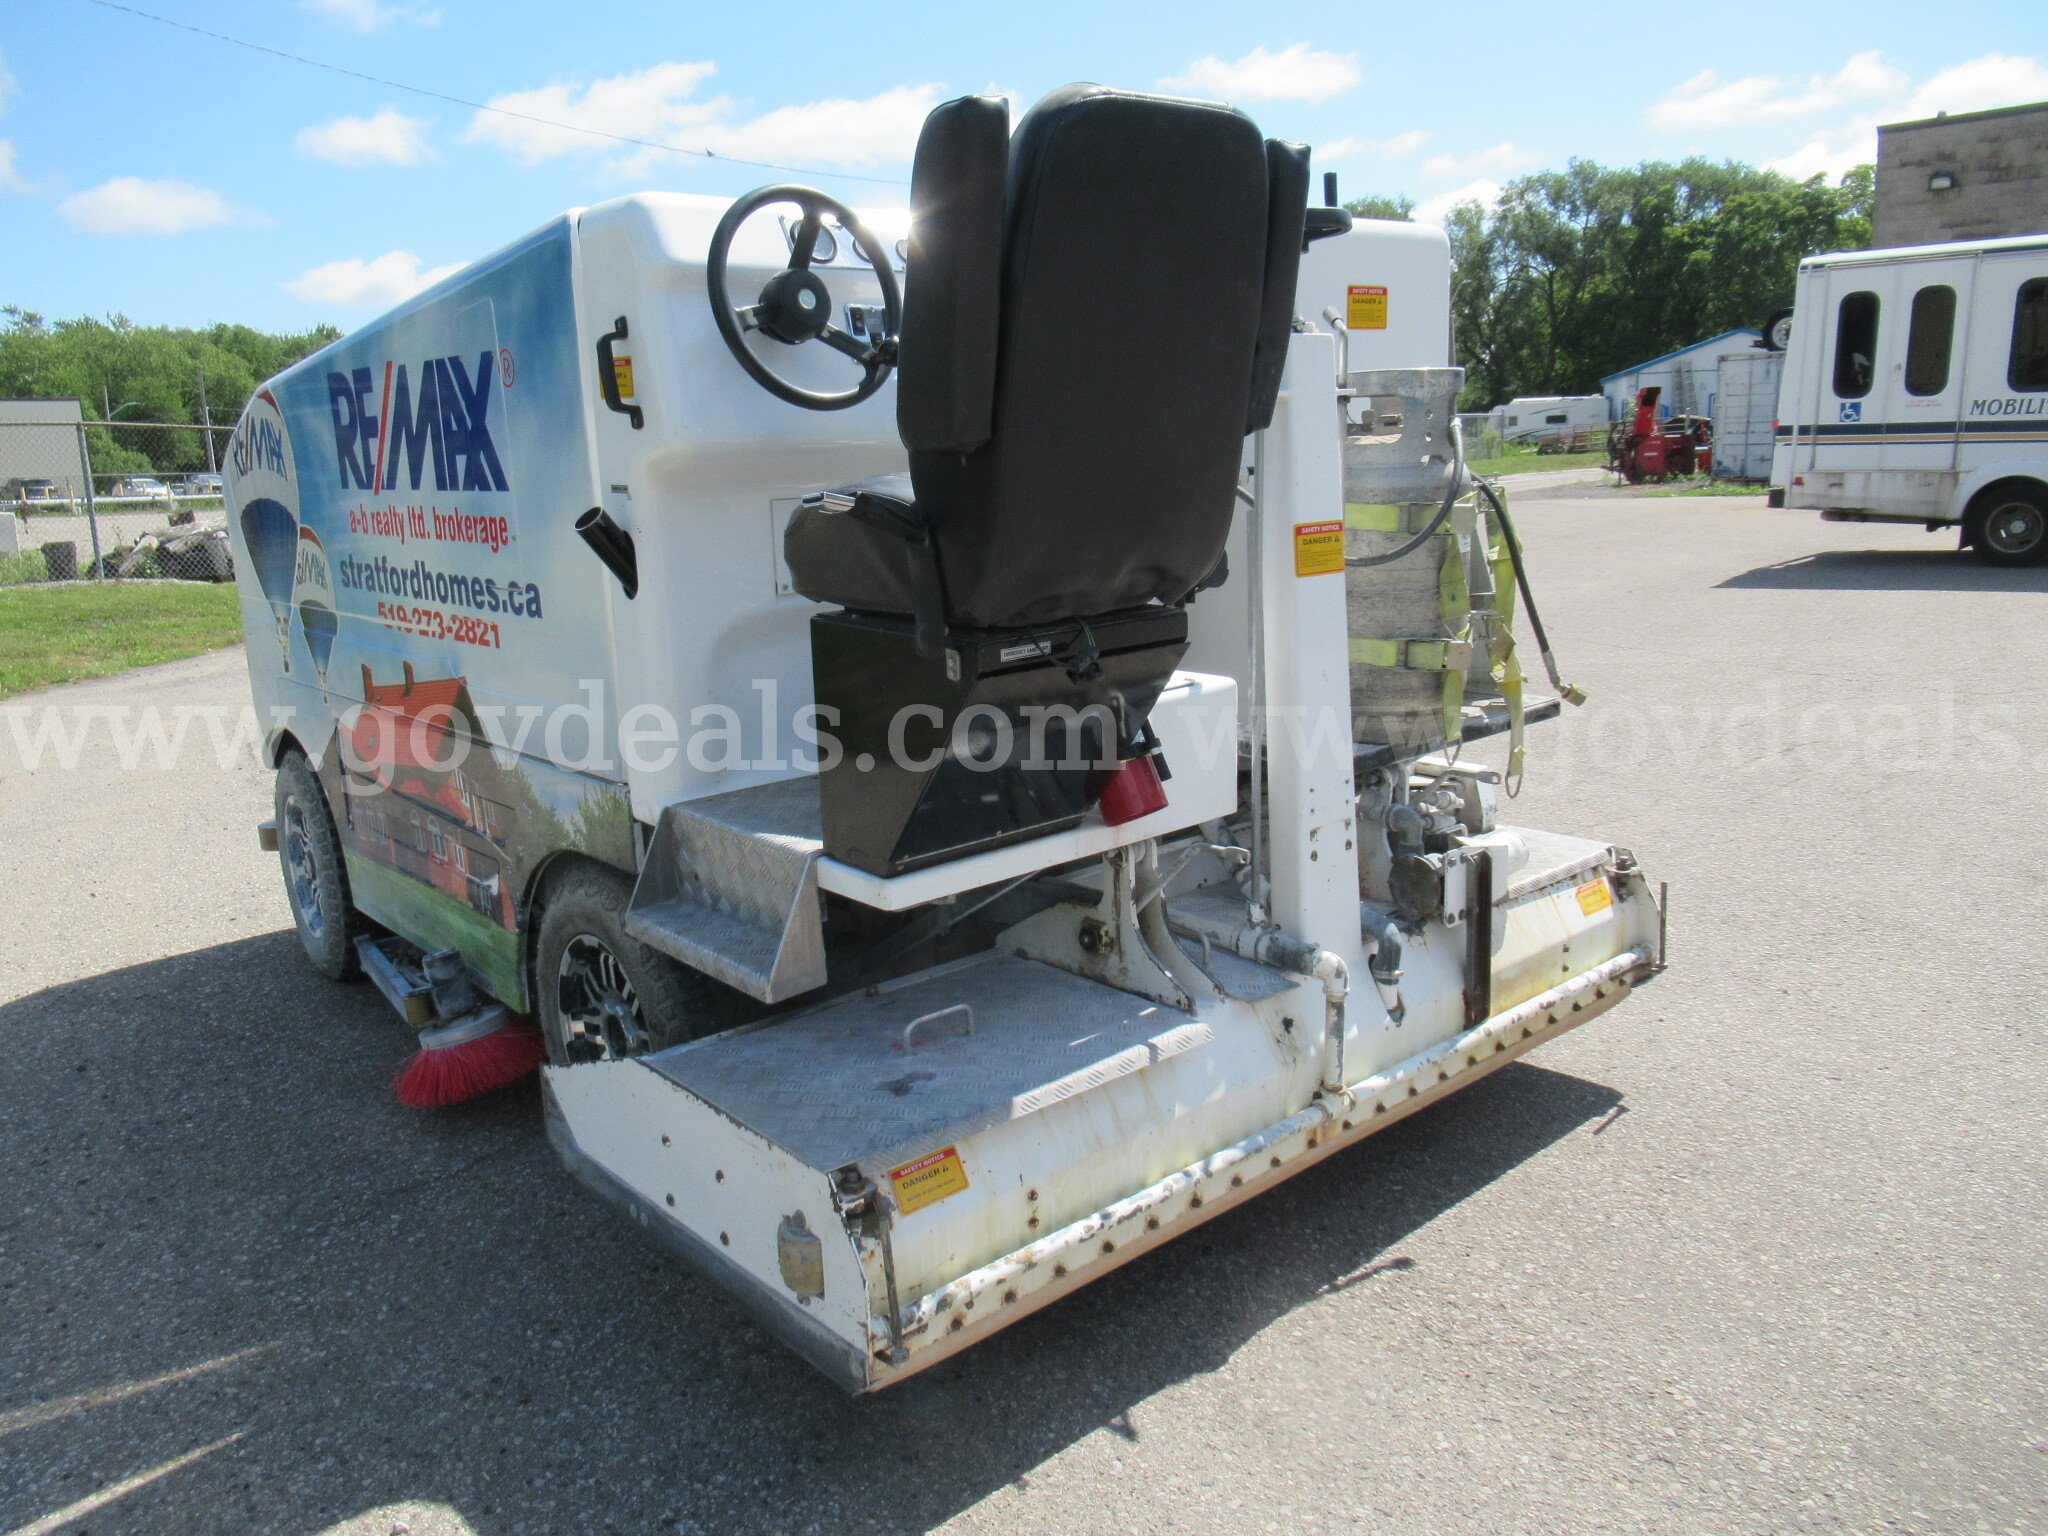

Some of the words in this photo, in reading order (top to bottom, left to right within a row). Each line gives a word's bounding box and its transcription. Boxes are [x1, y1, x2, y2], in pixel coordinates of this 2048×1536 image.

[327, 350, 511, 496] RE/MAX
[1969, 397, 2048, 416] MOBILI
[232, 412, 288, 482] RE/MAX
[350, 504, 369, 535] a-b
[371, 504, 405, 545] realty
[407, 505, 431, 539] ltd.
[432, 506, 509, 554] brokerage
[1301, 525, 1321, 534] SAFETY
[1321, 524, 1340, 532] NOTICE
[1303, 536, 1333, 545] DANGER
[339, 553, 543, 619] stratfordhomes.ca
[377, 601, 501, 649] 519-273-2821
[900, 1164, 923, 1176] SAFETY
[923, 1153, 945, 1167] NOTICE
[902, 1169, 941, 1189] DANGER
